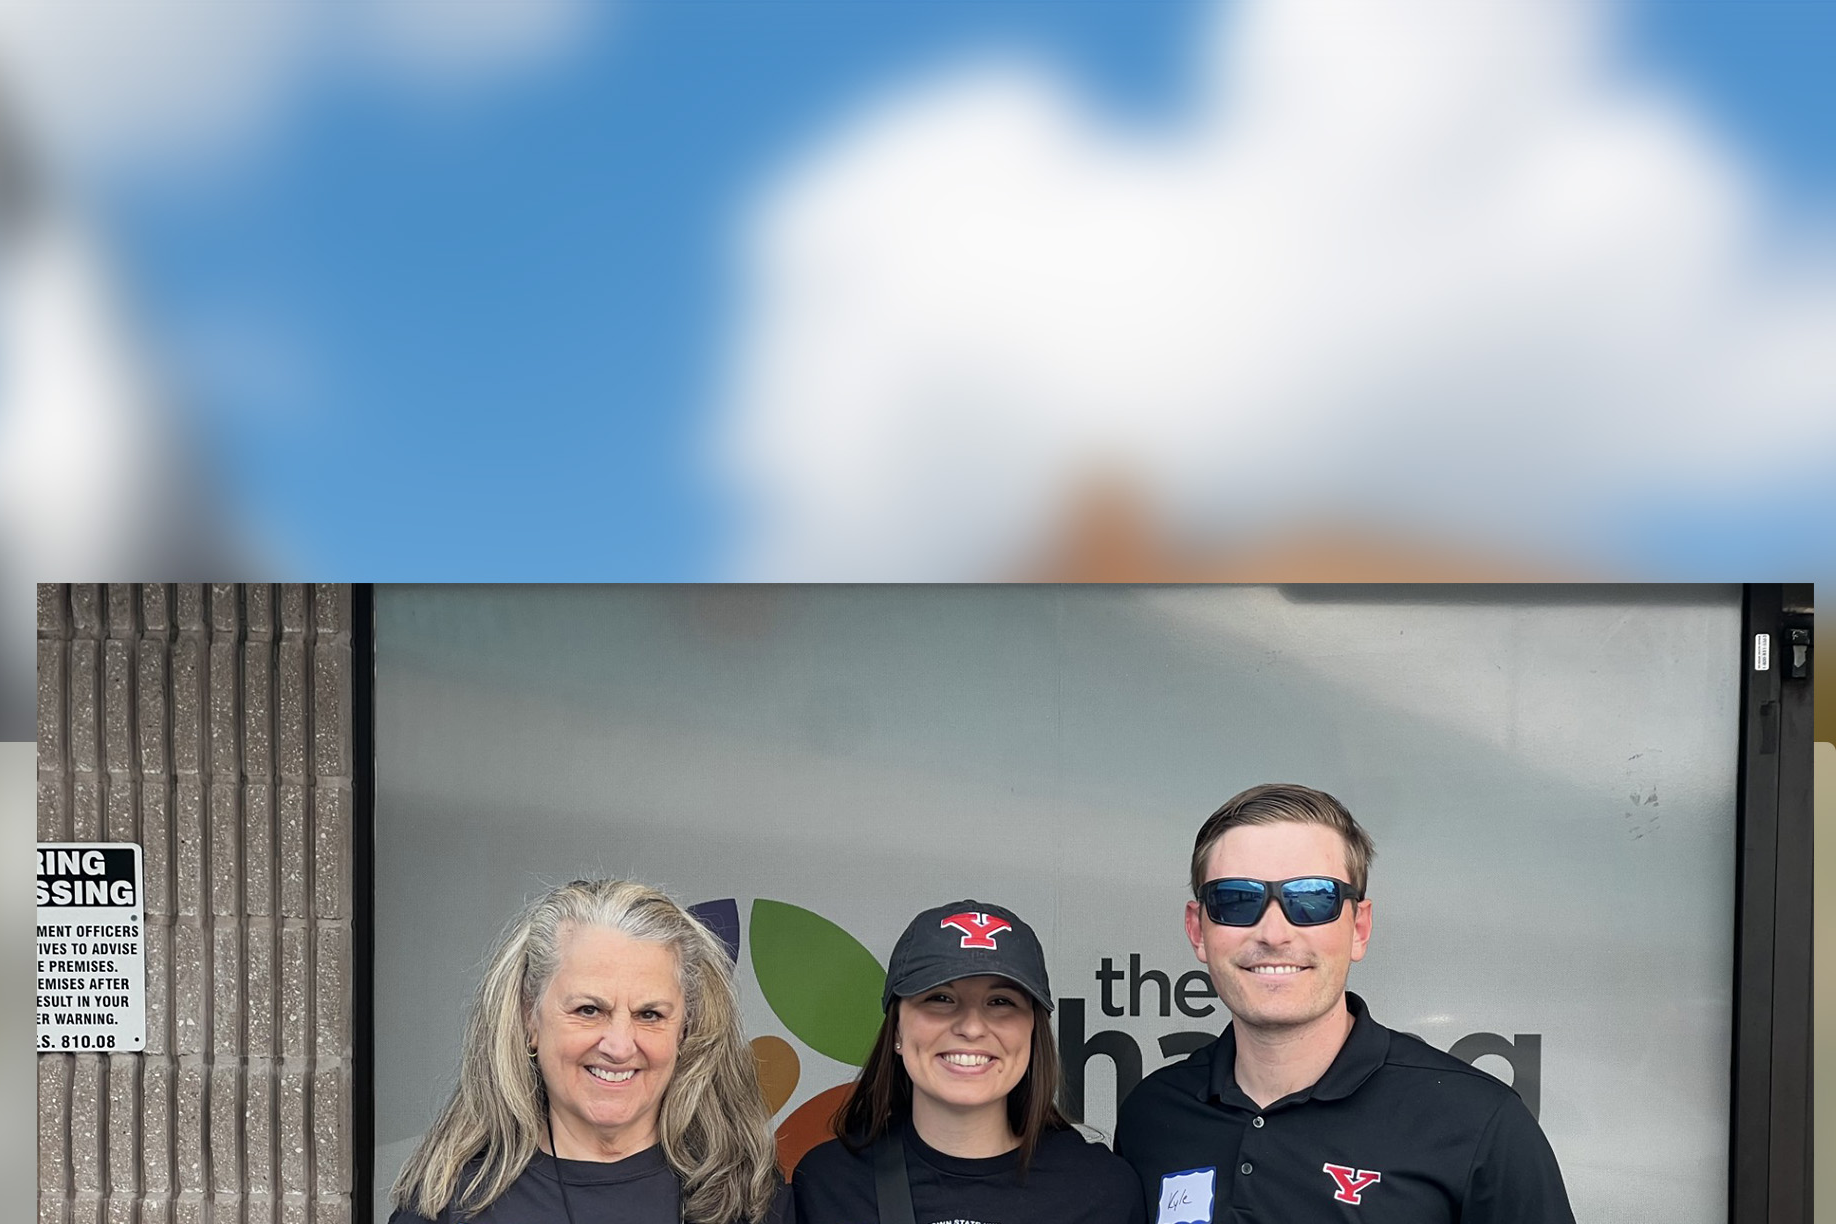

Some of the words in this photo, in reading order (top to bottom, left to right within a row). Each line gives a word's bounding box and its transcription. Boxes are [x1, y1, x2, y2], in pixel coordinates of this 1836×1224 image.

[76, 925, 139, 938] OFFICERS
[940, 911, 1012, 950] Y
[37, 943, 67, 955] IVES
[71, 943, 87, 955] TO
[92, 943, 138, 955] ADVISE
[49, 960, 118, 972] PREMISES.
[37, 978, 85, 990] EMISES
[89, 978, 130, 990] AFTER
[1095, 953, 1219, 1018] the
[77, 995, 90, 1007] IN
[94, 995, 129, 1008] YOUR
[54, 1013, 118, 1025] WARNING.
[61, 1034, 115, 1048] 810.08
[1323, 1162, 1381, 1205] Y
